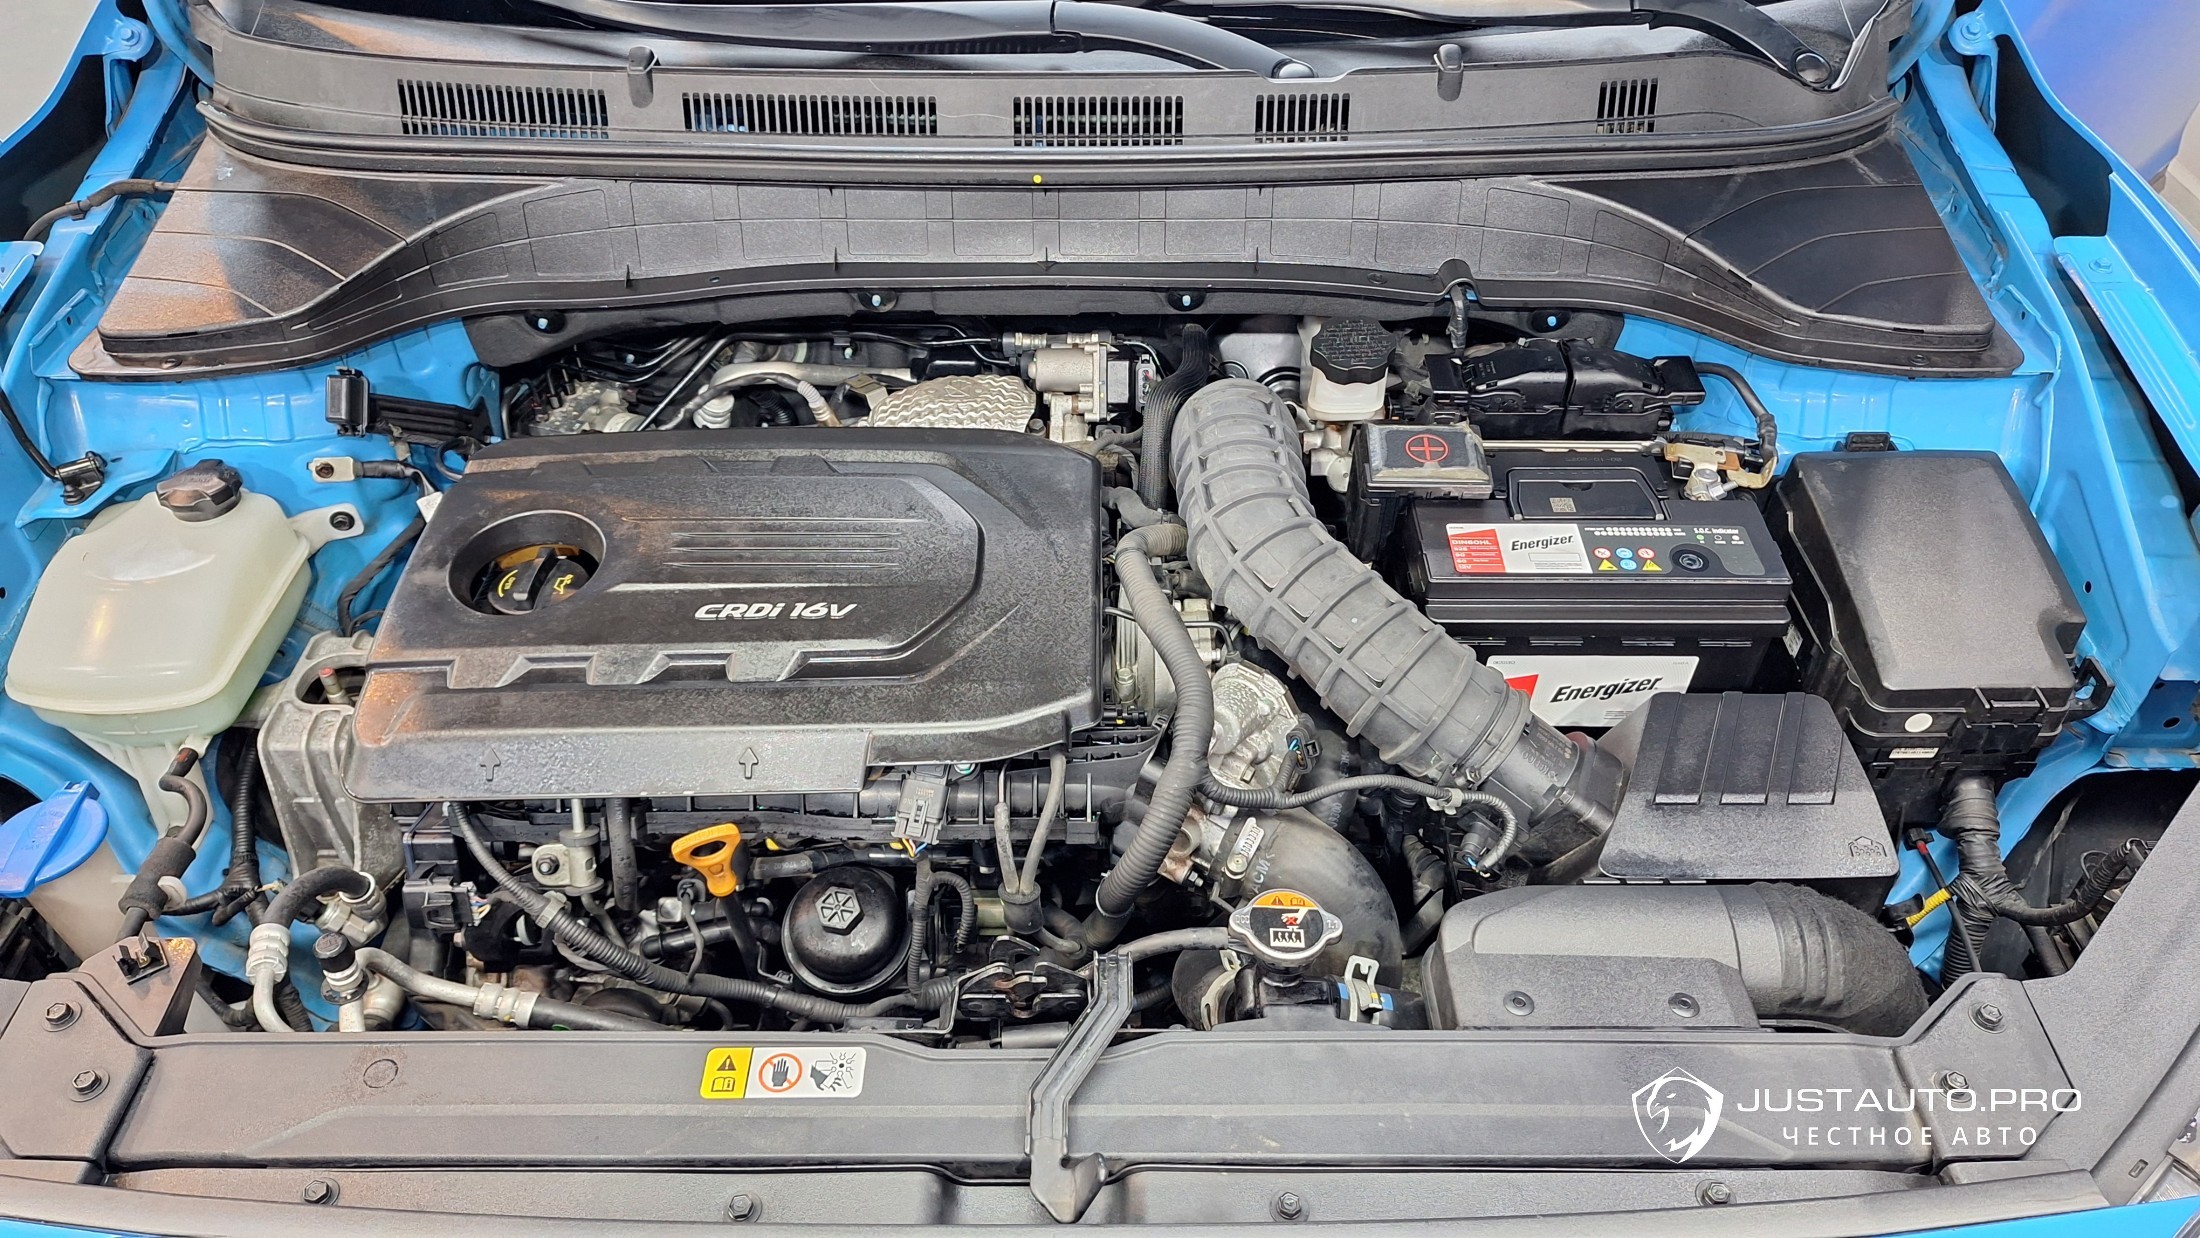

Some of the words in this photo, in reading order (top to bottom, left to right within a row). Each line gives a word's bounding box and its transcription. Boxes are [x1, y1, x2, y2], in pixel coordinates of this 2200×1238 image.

[1511, 535, 1573, 551] Energizer
[694, 602, 786, 620] CRDi
[789, 602, 858, 620] 16V
[1549, 676, 1664, 703] Energizer
